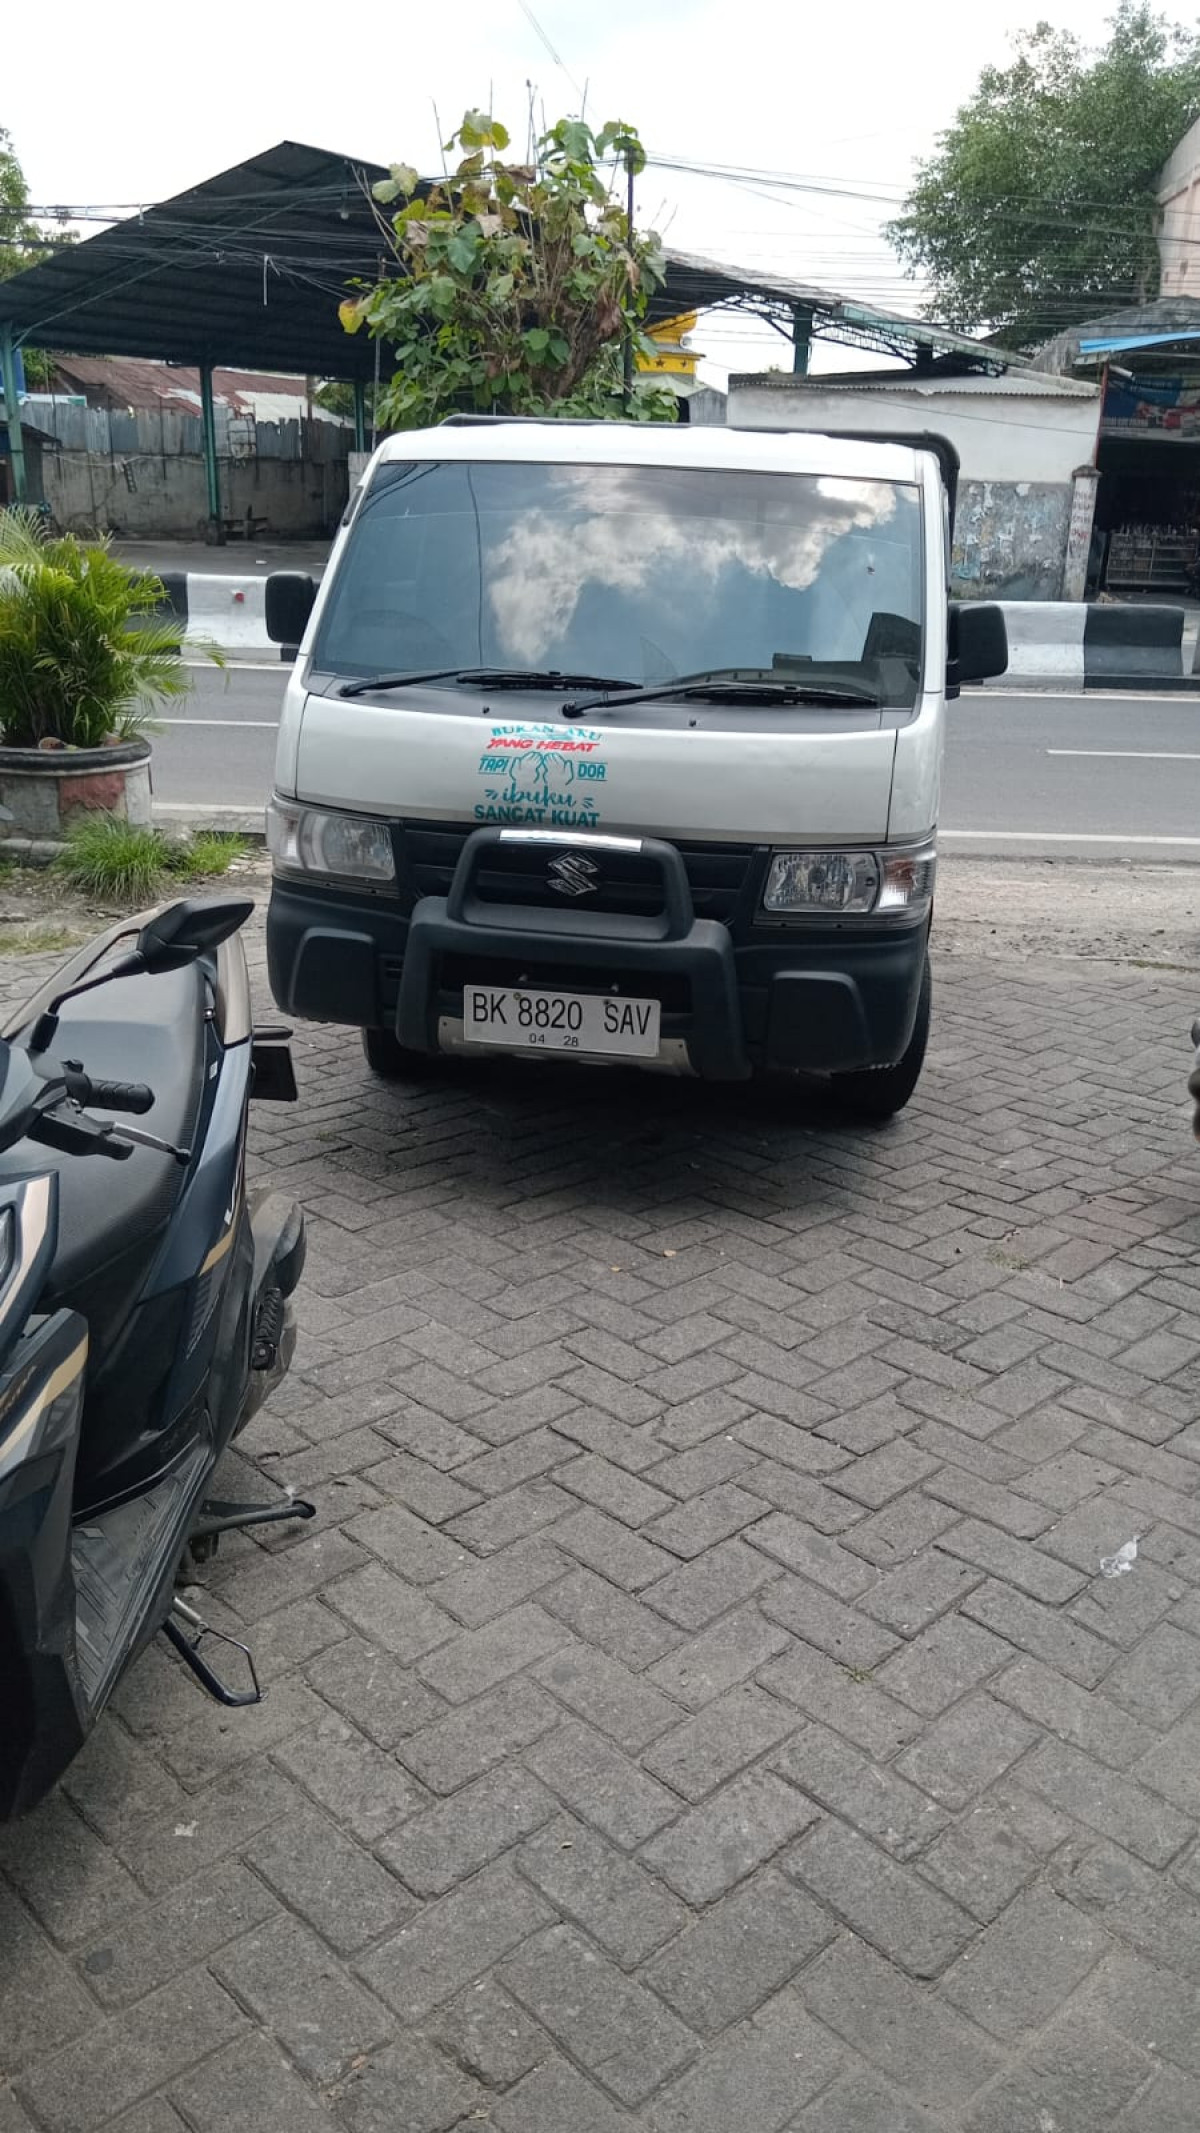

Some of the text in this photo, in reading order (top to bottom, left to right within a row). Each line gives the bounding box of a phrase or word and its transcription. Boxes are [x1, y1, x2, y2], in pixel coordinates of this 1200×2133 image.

[487, 738, 601, 753] YANG HEBAT
[479, 757, 606, 779] TAPI DOA
[502, 783, 577, 808] ibuku
[551, 810, 601, 828] KUAT
[472, 992, 652, 1035] BK 8820 SAV
[529, 1033, 579, 1047] 04 28
